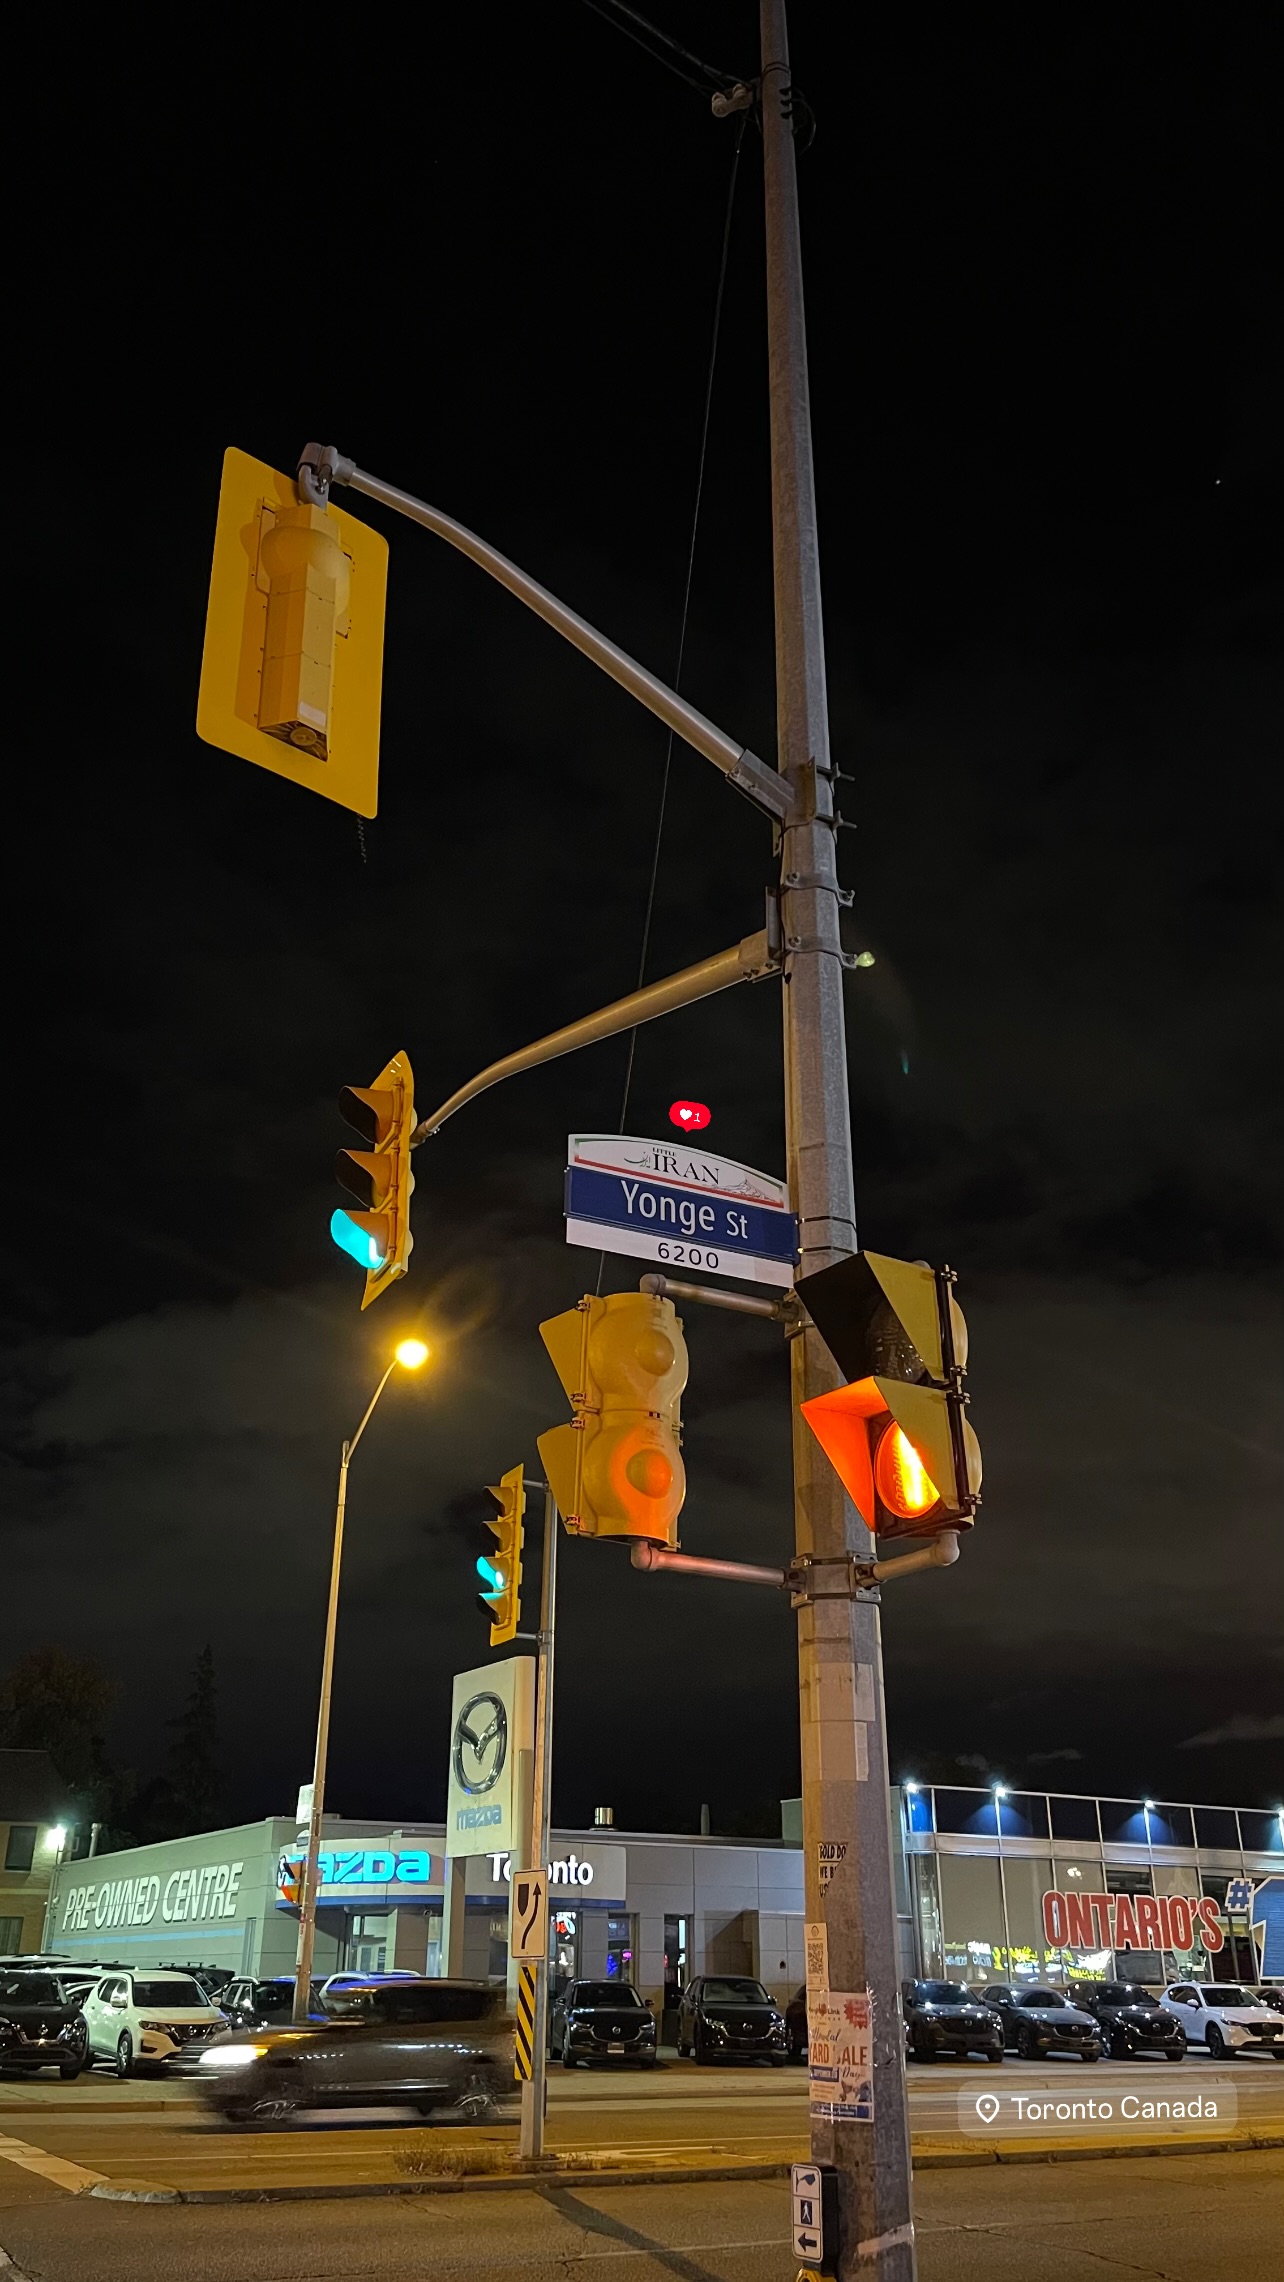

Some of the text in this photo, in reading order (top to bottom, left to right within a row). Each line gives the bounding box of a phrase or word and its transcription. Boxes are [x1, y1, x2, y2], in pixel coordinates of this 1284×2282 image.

[652, 1147, 676, 1156] LITTLE
[653, 1153, 719, 1185] IRAN
[621, 1180, 748, 1239] Yonge St
[658, 1242, 719, 1269] 6200
[456, 1803, 502, 1832] mazda
[62, 1862, 244, 1931] PRE-OWNED CENTRE
[1042, 1889, 1225, 1954] ONTARIO'S
